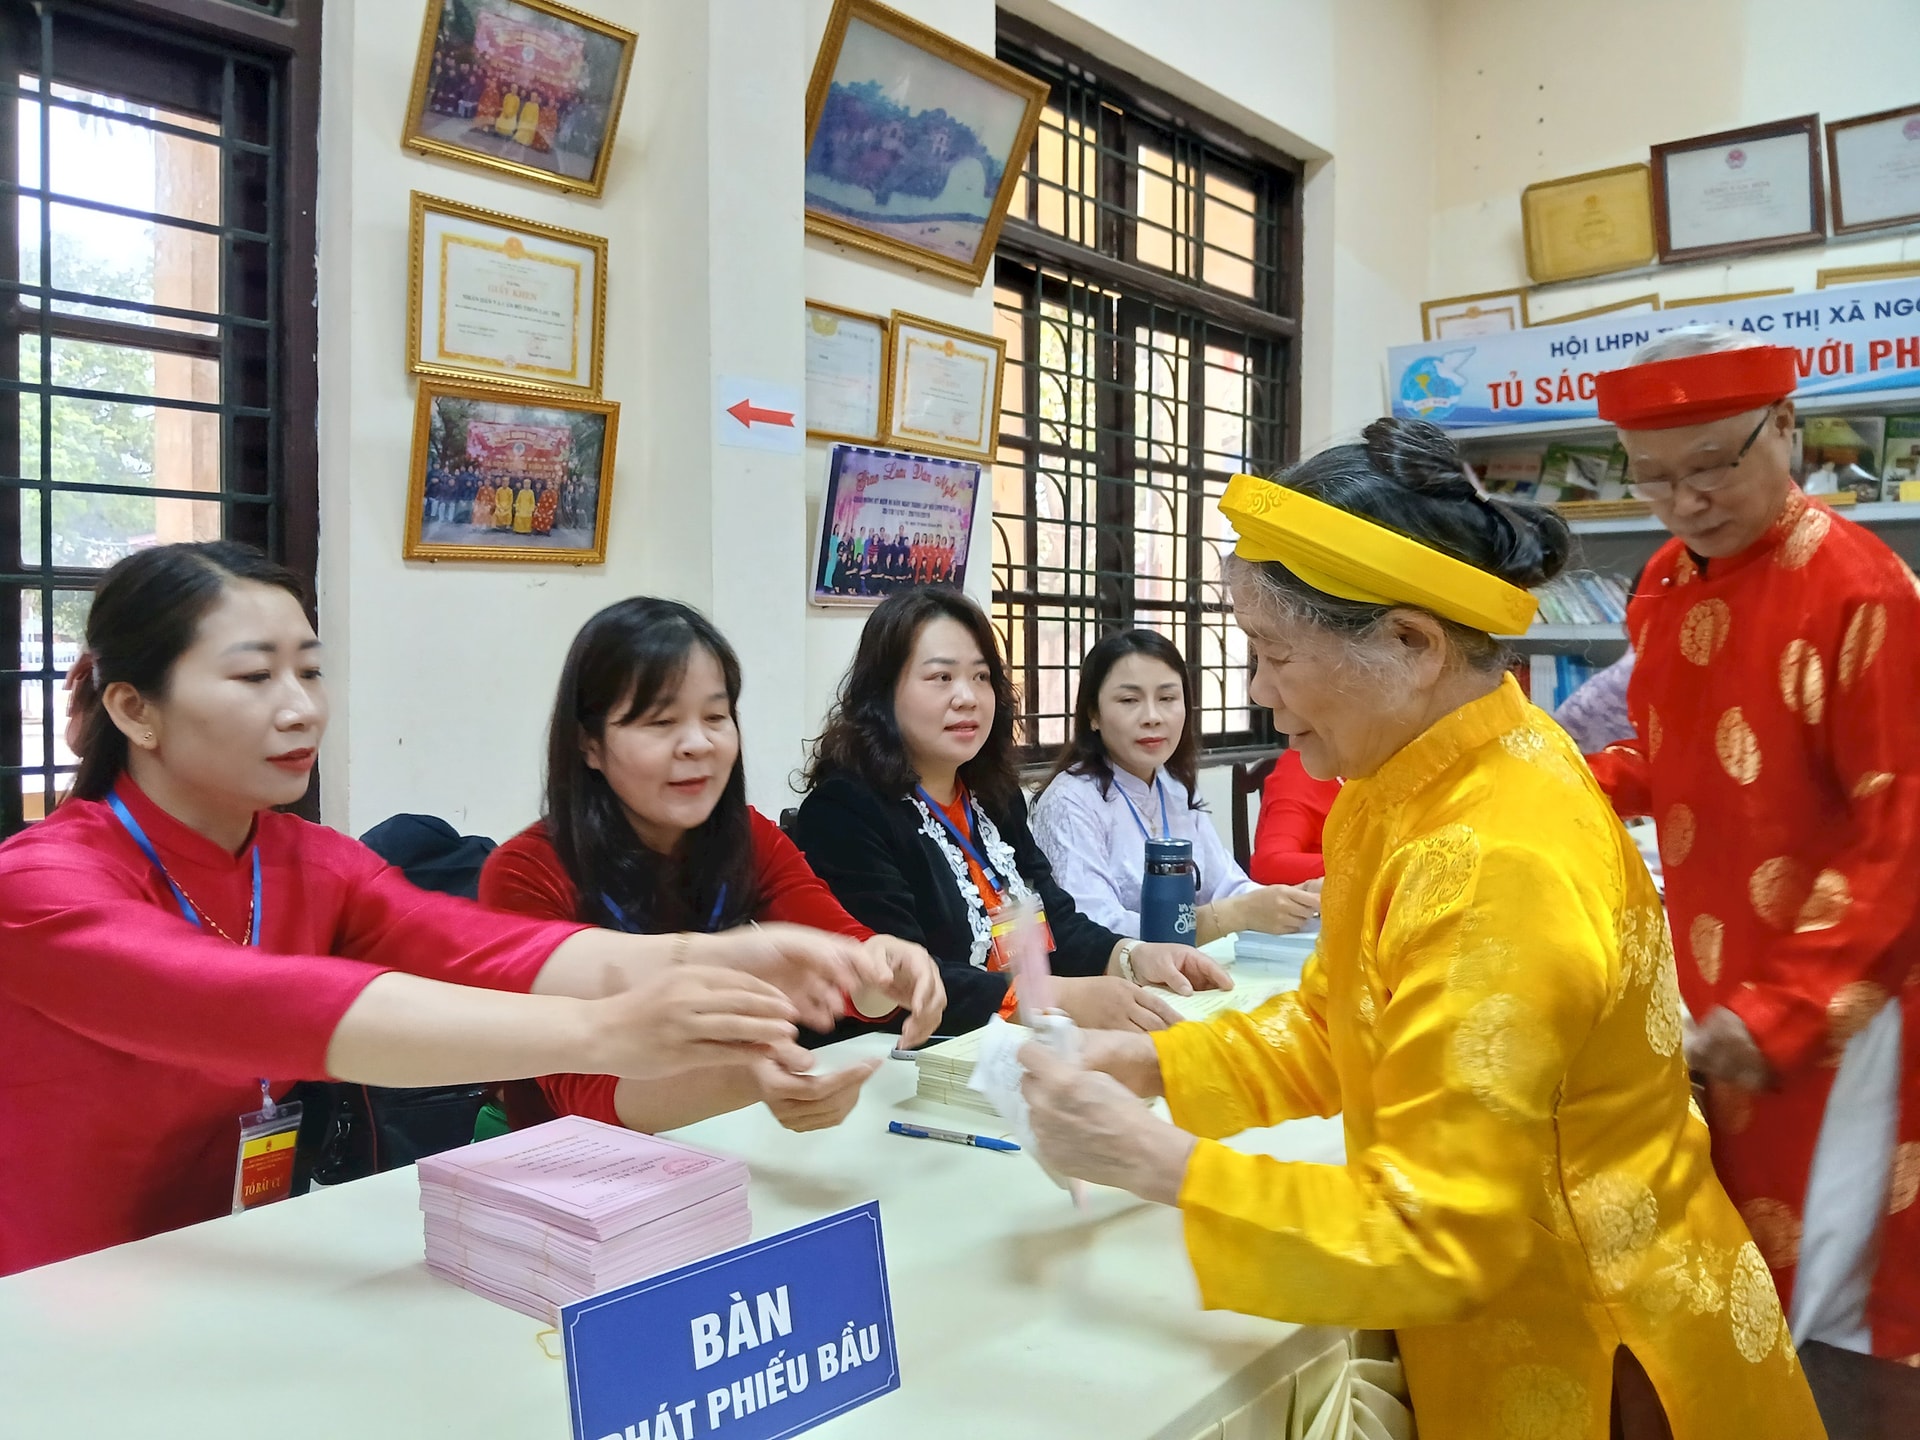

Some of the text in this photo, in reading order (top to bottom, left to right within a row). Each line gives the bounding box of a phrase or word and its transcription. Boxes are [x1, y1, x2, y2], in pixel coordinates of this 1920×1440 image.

[1551, 335, 1588, 360] HỘI
[1596, 330, 1649, 352] LHPN
[1783, 308, 1819, 331] THỊ
[1829, 299, 1865, 325] XÃ
[1874, 297, 1920, 320] NG
[1488, 370, 1523, 410] TỦ
[1534, 368, 1600, 405] SÁC
[1795, 337, 1854, 378] VỚI
[690, 1285, 793, 1371] BÀN
[596, 1320, 881, 1440] HÁT PHIẾU BẦU
